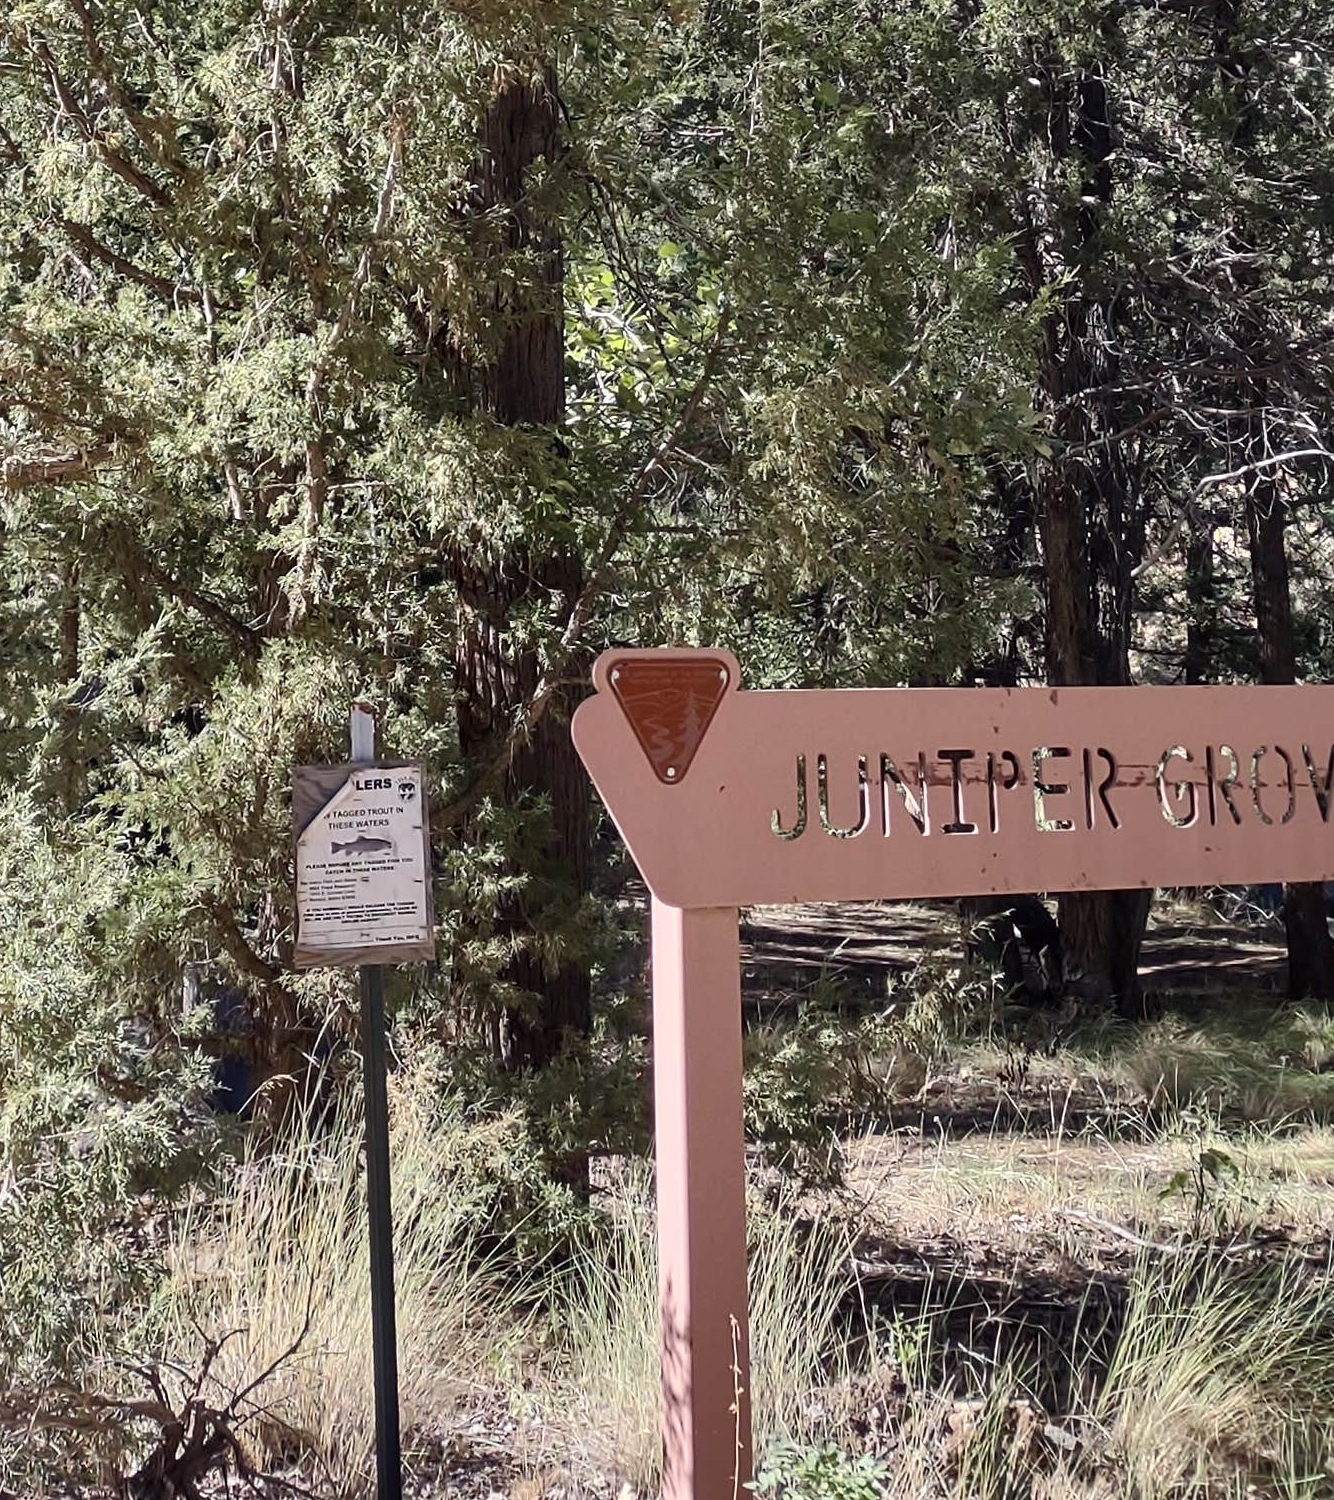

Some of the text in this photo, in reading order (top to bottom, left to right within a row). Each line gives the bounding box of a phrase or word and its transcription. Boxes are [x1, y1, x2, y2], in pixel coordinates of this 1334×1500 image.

[352, 778, 392, 791] LERS
[770, 746, 1123, 841] JUNIPER
[333, 809, 365, 818] TAGGED
[367, 807, 394, 816] TROUT
[396, 806, 404, 814] IN
[328, 819, 390, 830] THESE WATERS
